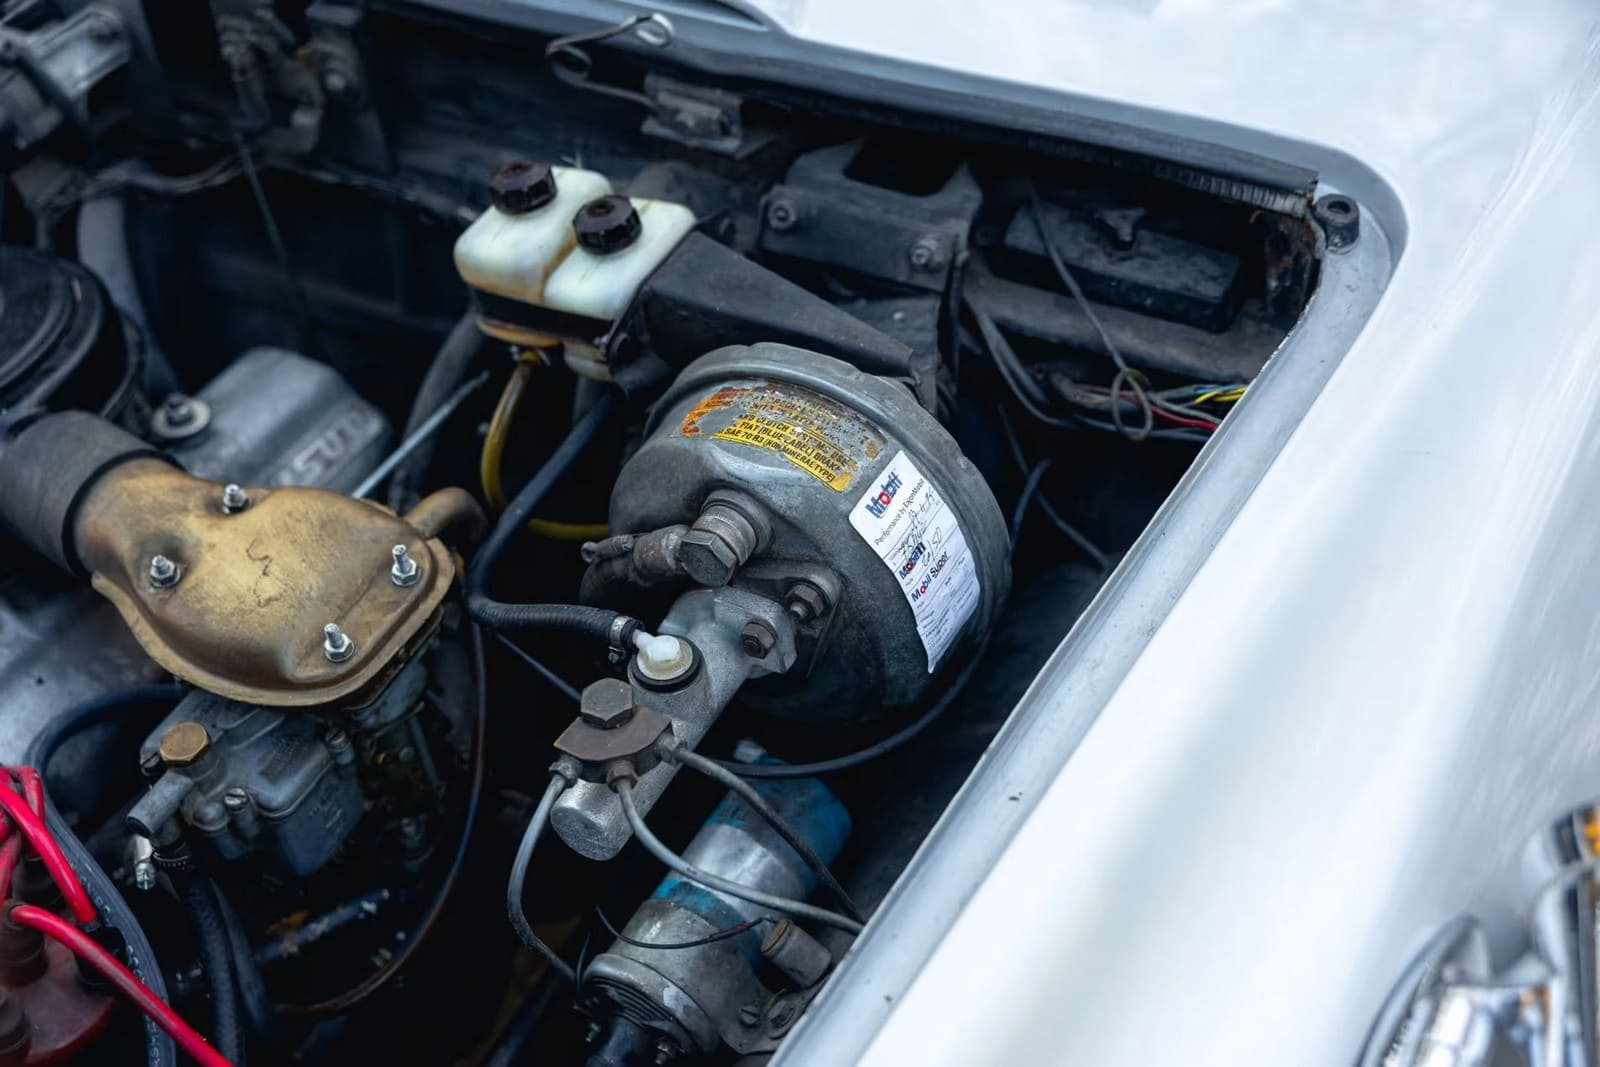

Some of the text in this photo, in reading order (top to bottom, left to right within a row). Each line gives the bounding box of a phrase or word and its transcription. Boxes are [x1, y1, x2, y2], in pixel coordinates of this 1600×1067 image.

[724, 428, 742, 437] SAE
[742, 431, 753, 439] 70
[740, 421, 759, 431] FIAT
[755, 417, 791, 432] CLUTCH
[830, 450, 848, 467] USE
[865, 471, 903, 519] Mobil
[873, 514, 901, 546] Performance
[911, 573, 933, 602] Mobil
[930, 551, 950, 579] Super
